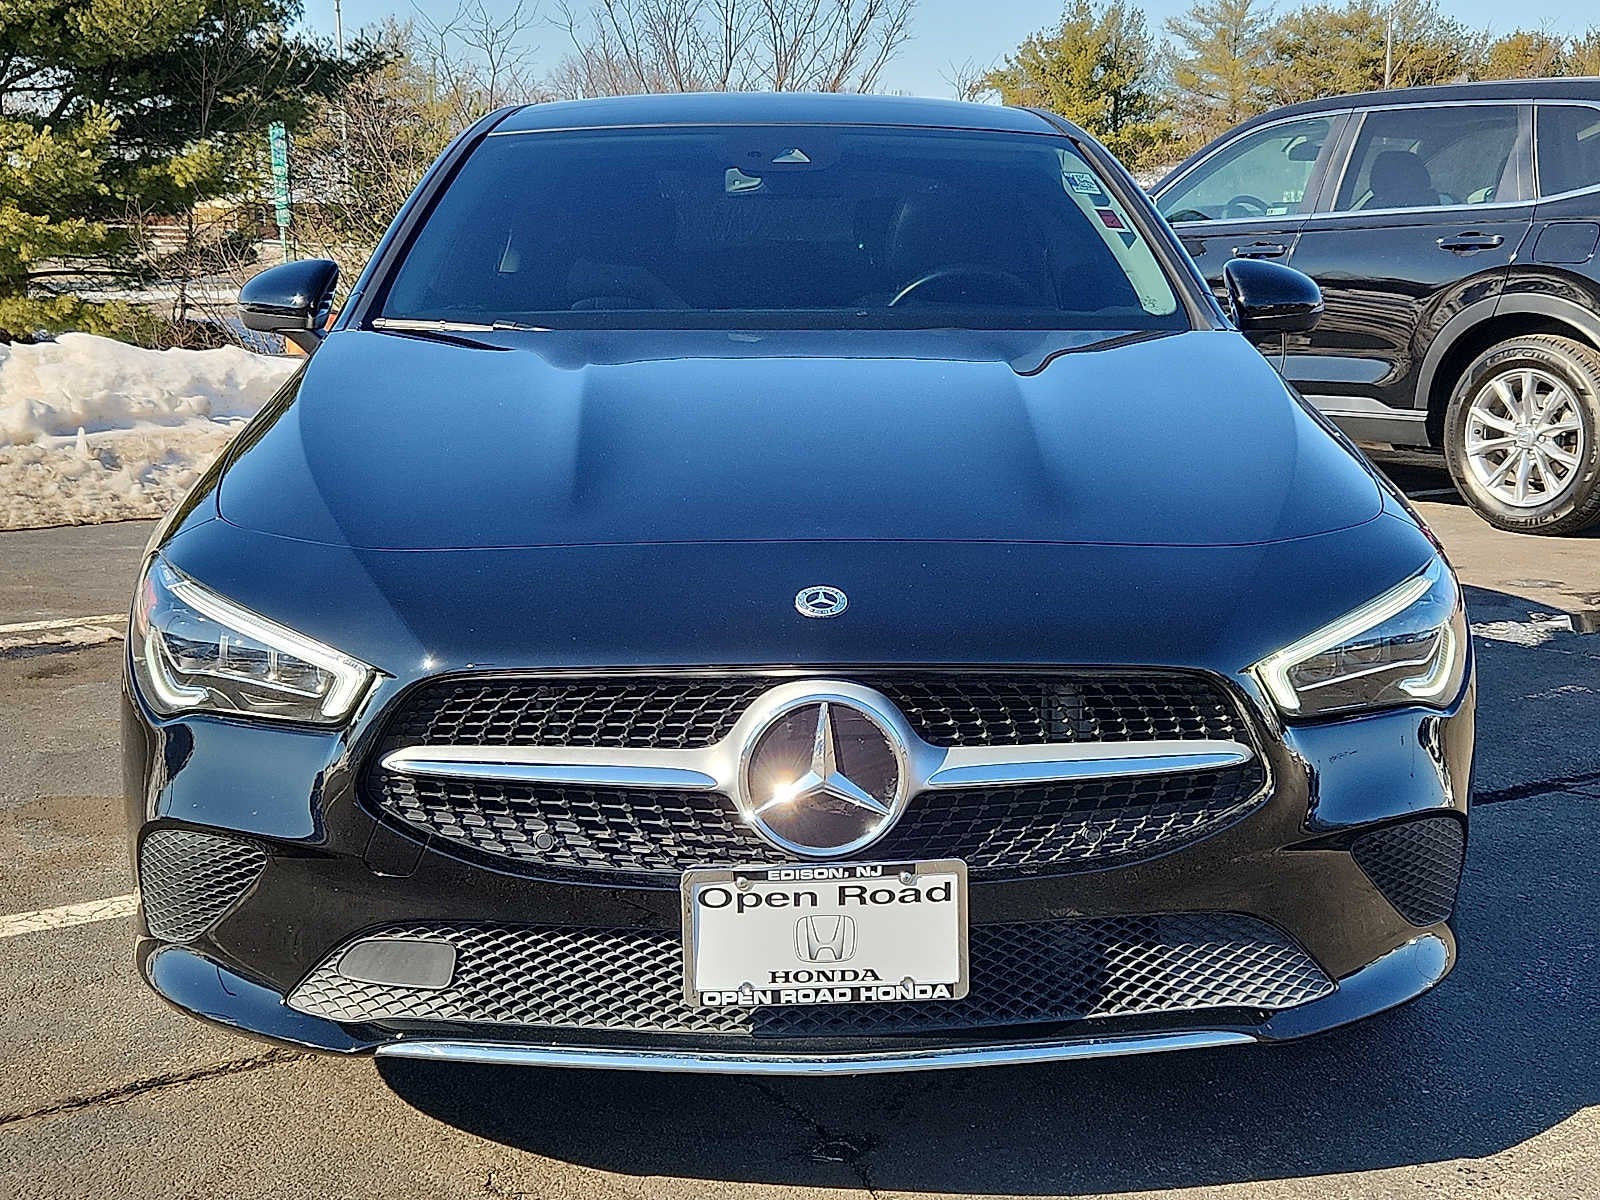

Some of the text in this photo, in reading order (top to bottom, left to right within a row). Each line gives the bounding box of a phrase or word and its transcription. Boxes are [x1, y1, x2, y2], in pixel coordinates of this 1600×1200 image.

[767, 865, 882, 880] EDISON, NJ
[698, 881, 951, 913] Open Road
[768, 969, 882, 984] HONDA
[702, 984, 951, 1006] OPEN ROAD HONDA
